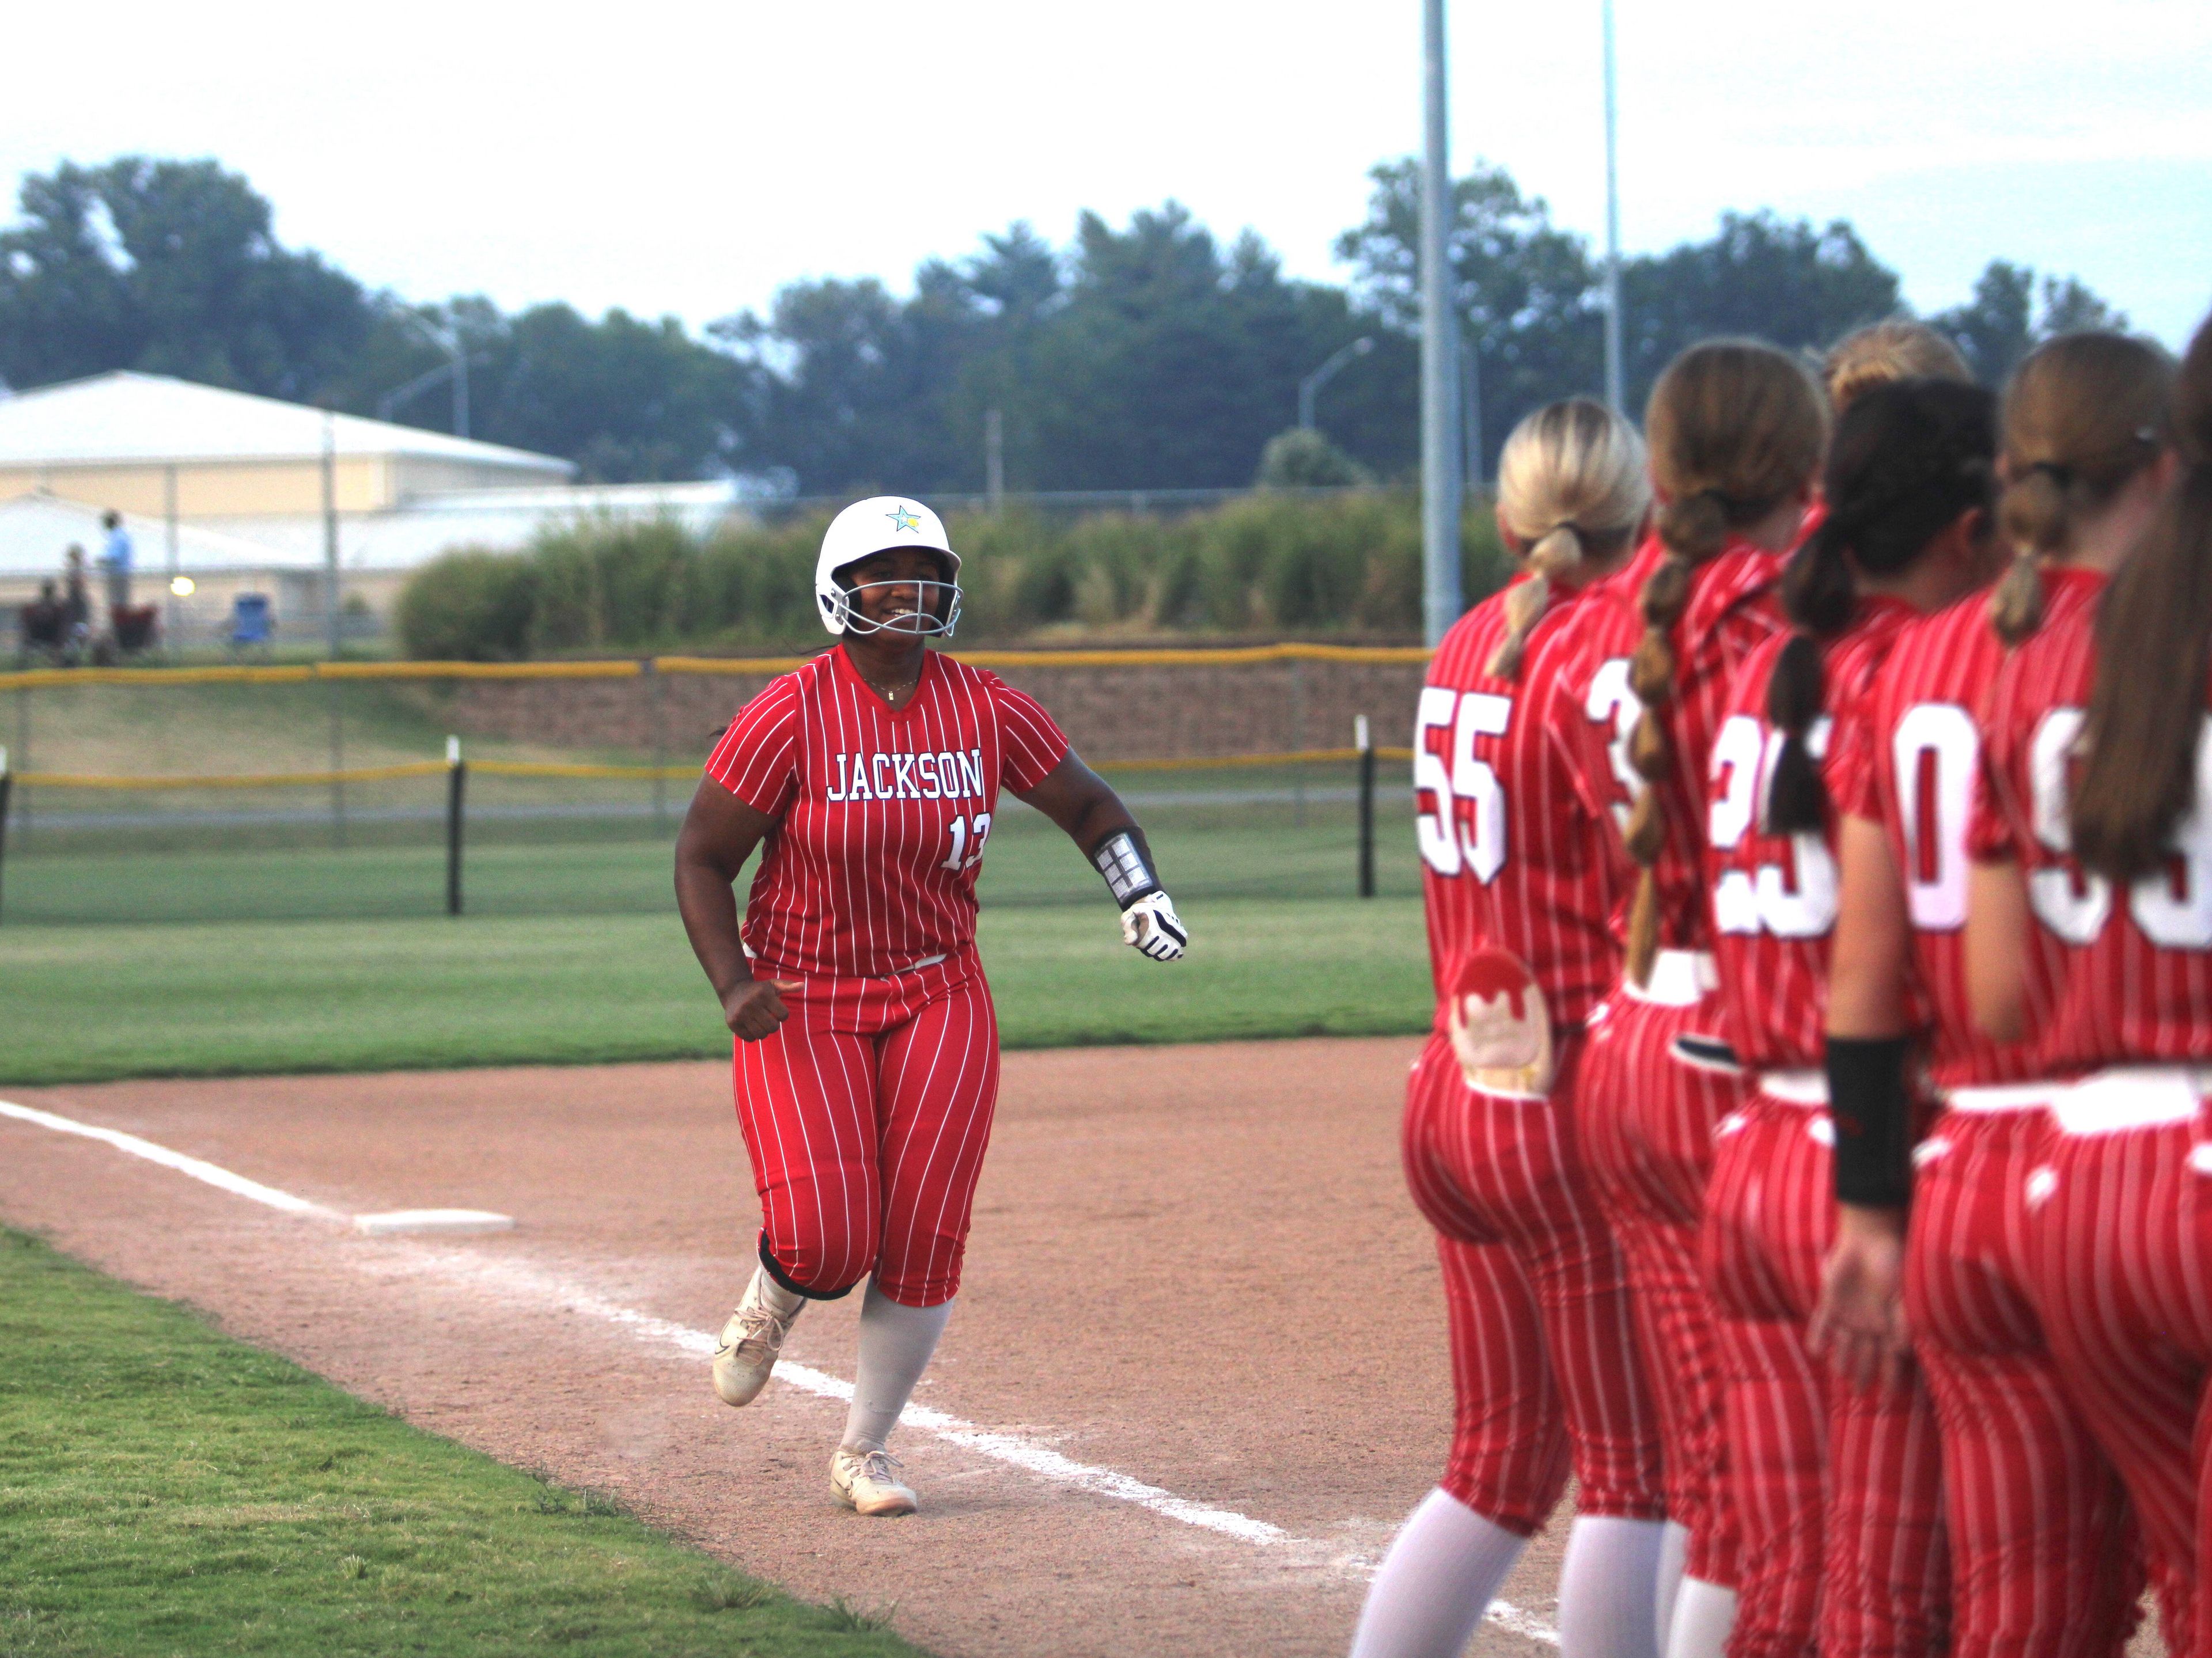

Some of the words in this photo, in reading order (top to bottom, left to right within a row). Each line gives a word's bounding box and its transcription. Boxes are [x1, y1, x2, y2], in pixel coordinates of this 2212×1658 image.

[827, 749, 983, 802] JACKSON
[1414, 686, 1511, 885] 55
[1893, 701, 1982, 929] 0
[941, 813, 992, 870] 13
